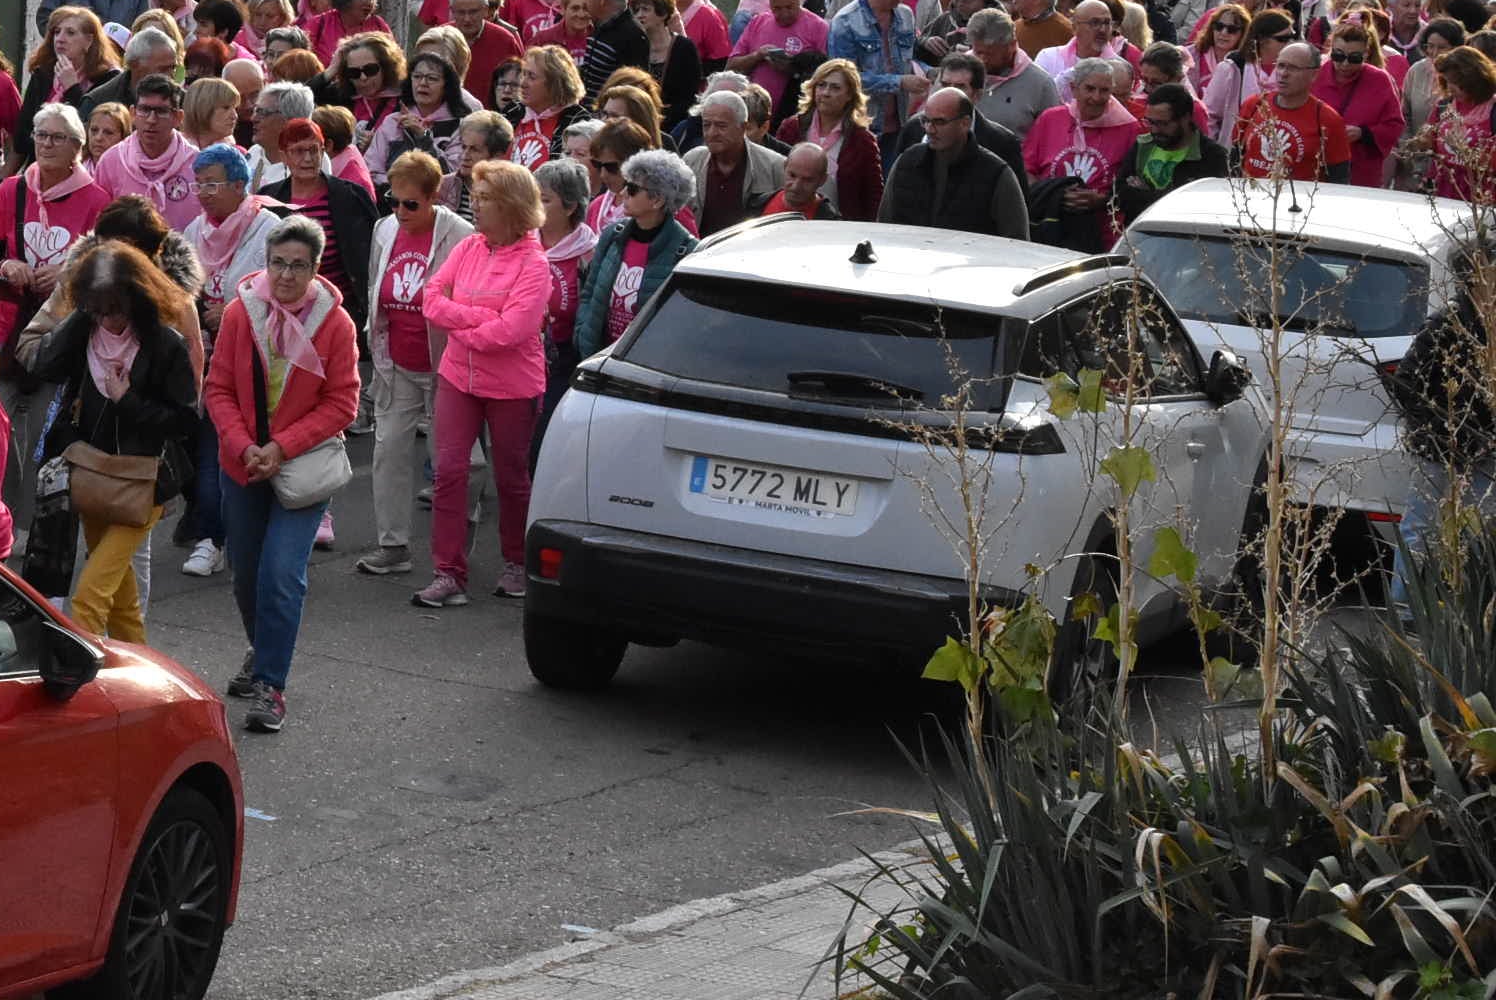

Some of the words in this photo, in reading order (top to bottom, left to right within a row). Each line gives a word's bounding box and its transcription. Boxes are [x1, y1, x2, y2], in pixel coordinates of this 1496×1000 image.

[711, 464, 785, 499] 5772
[792, 475, 851, 509] MLY
[607, 495, 655, 508] 2008
